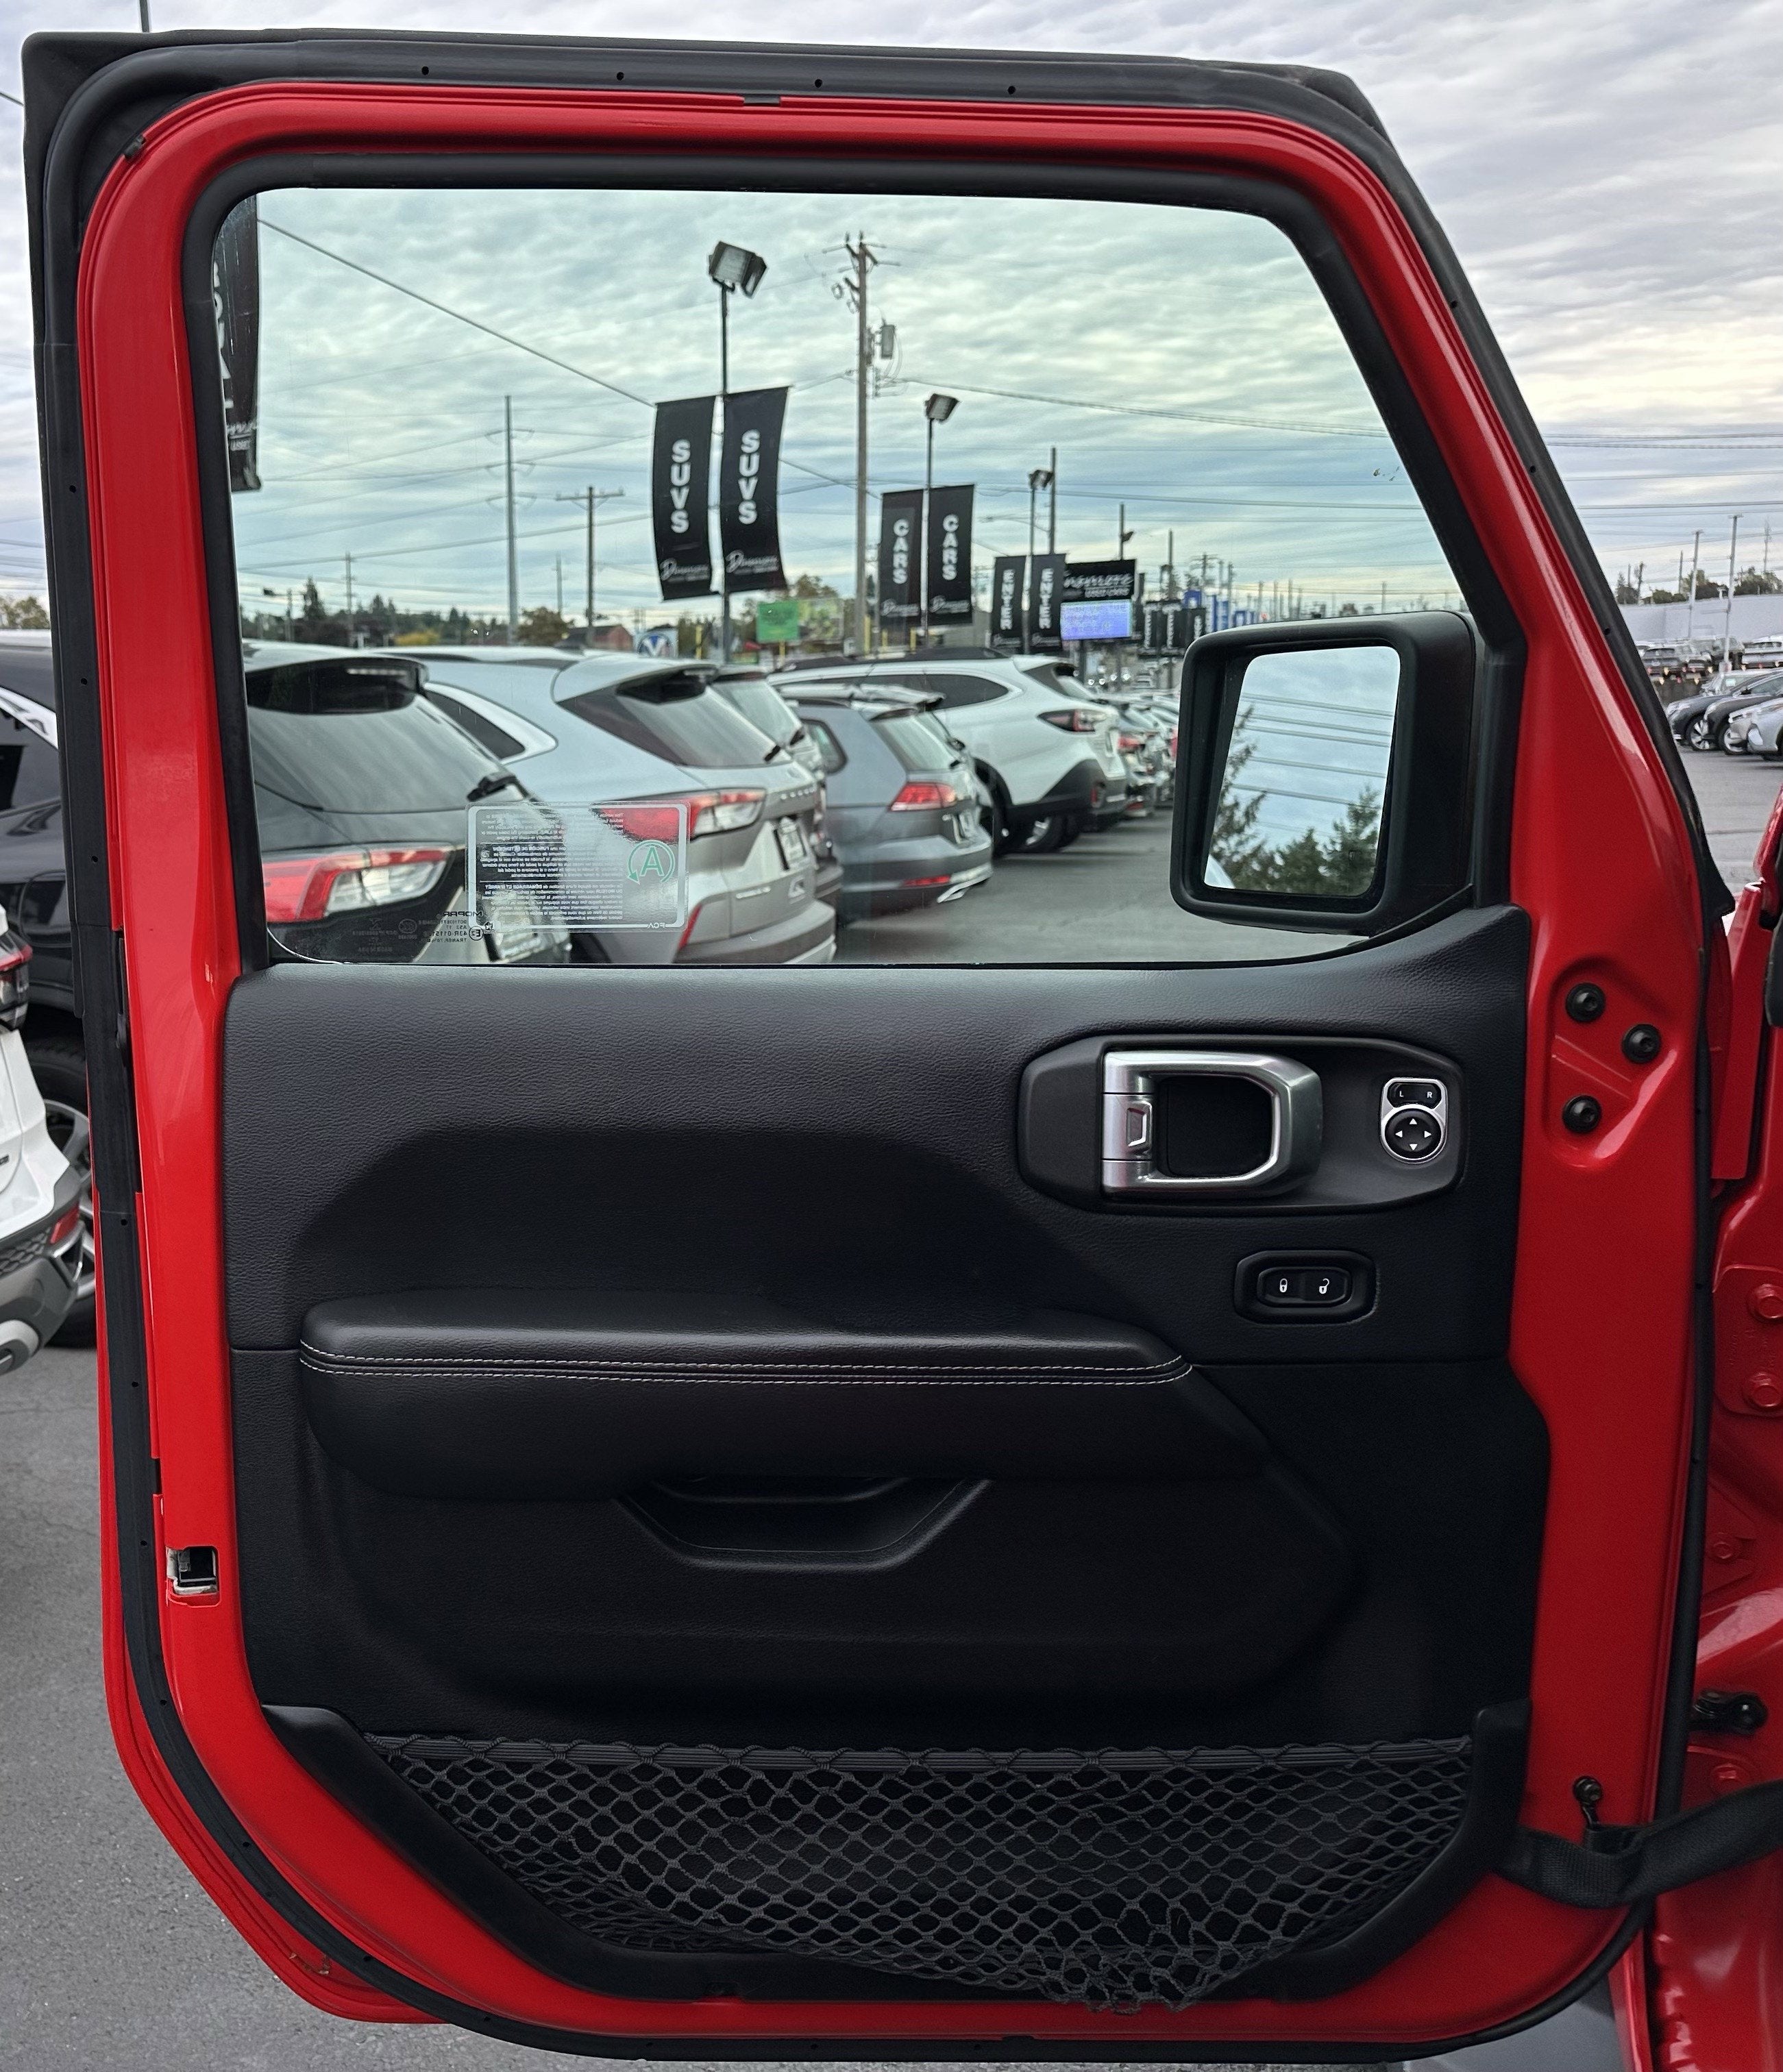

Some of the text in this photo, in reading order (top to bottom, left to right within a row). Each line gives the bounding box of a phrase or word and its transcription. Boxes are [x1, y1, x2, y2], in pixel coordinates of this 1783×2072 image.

[670, 439, 691, 534] SUVS
[737, 428, 761, 526] SUVS
[893, 518, 910, 585] CARS
[942, 513, 959, 582] CARS
[1000, 568, 1016, 630] ENTER
[1038, 567, 1054, 630] ENTER
